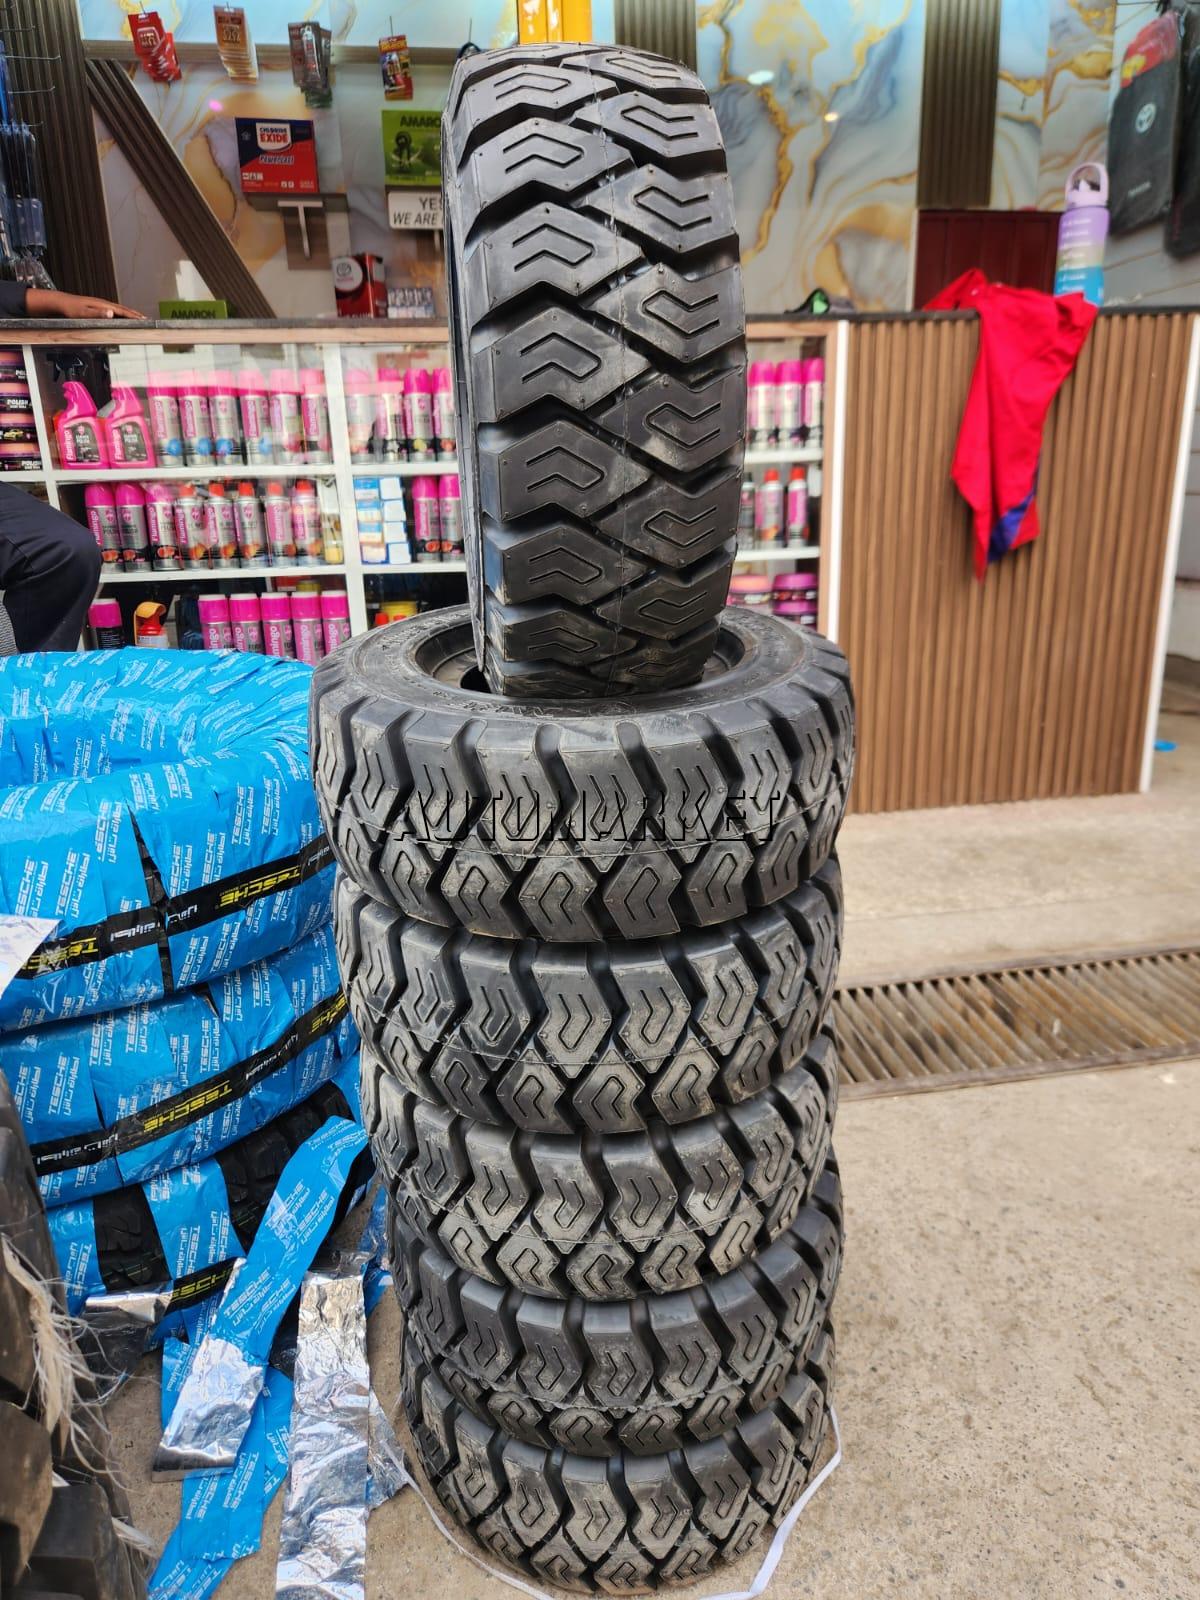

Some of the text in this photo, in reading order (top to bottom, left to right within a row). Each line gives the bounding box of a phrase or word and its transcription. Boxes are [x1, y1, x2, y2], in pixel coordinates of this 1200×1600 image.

[260, 134, 289, 143] EXIDE
[401, 115, 442, 128] AMARO
[393, 211, 439, 226] WE ARE
[170, 309, 217, 319] AMARON
[64, 431, 75, 460] Flamingo
[231, 786, 246, 844] TESCHE
[15, 858, 36, 916] ESCHE
[55, 851, 77, 916] TESCHE
[219, 867, 300, 907] TESCHE
[222, 976, 233, 1022] TESCH
[89, 1016, 103, 1066] TESCH
[125, 1005, 138, 1053] TESCH
[200, 1017, 212, 1073] TESCHE
[48, 1055, 69, 1115] TESCHE
[143, 1084, 233, 1133] TESCHE
